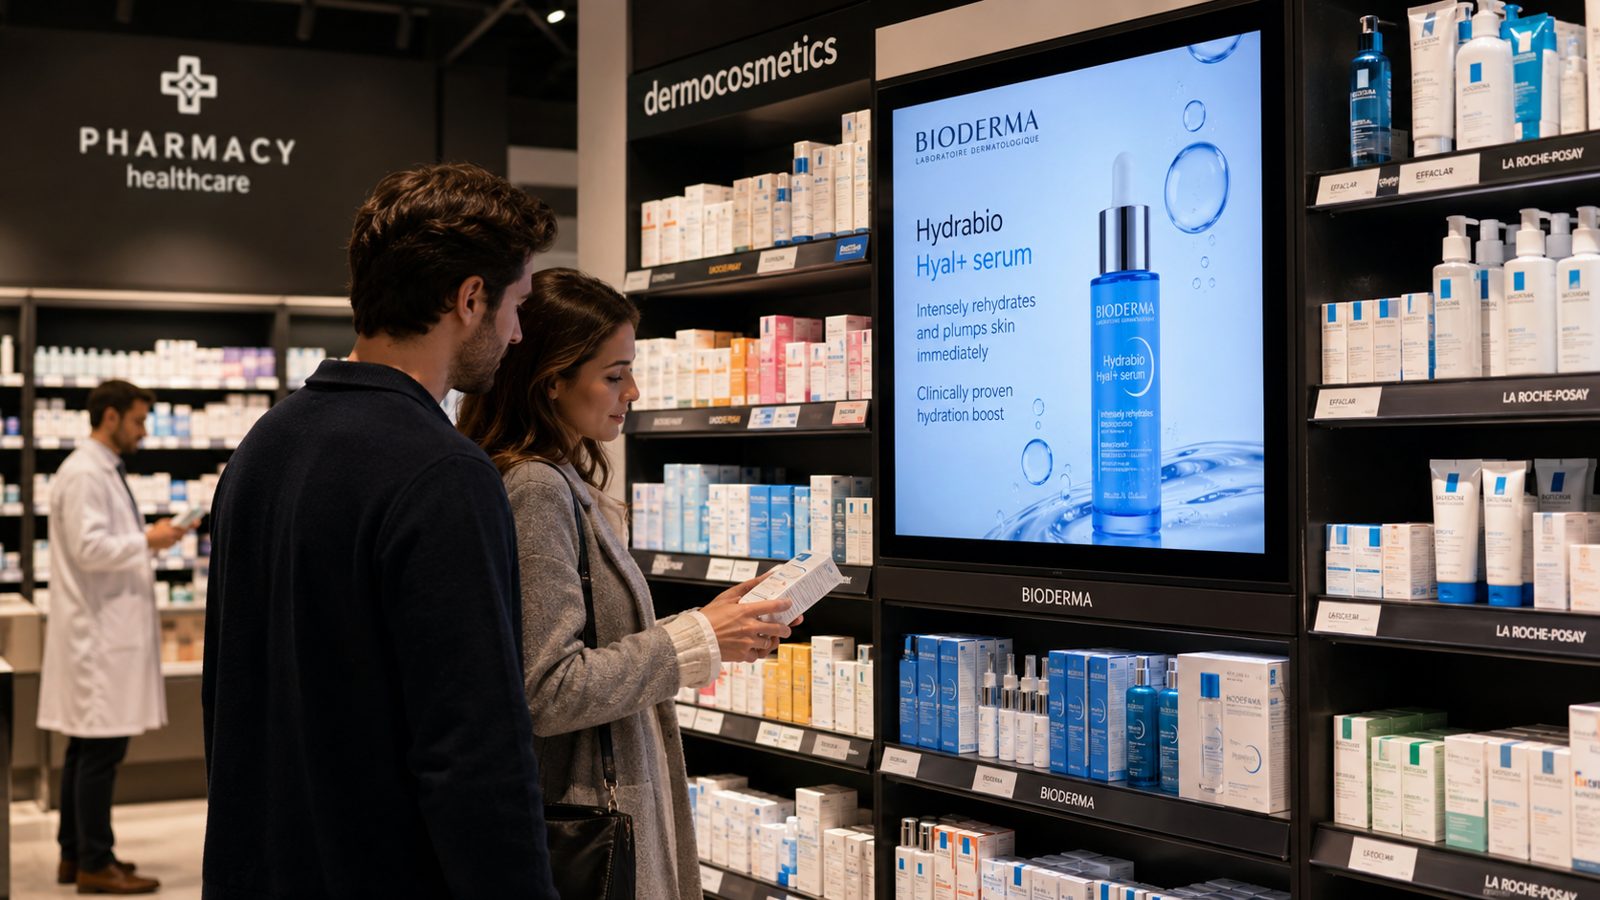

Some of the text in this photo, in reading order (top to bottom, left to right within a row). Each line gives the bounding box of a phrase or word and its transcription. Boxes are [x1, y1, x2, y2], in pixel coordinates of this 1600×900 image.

[644, 34, 838, 116] dermocosmetics
[915, 109, 1039, 152] BIODERMA
[79, 126, 296, 165] PHARMACY
[915, 134, 1039, 165] LABORATOIRE DERMATOLOGIQUE
[1502, 147, 1584, 170] LA ROCHE-POSAY
[126, 163, 250, 194] healthcare
[1414, 167, 1454, 180] EFFACLAR
[916, 208, 1003, 246] Hydrabio
[916, 247, 1032, 281] Hyal+ serum
[916, 294, 1036, 317] Intensely rehydrates
[1096, 302, 1155, 318] BIODERMA
[916, 318, 1015, 341] and plumps skin
[917, 343, 989, 362] immediately
[1103, 353, 1146, 370] Hydrabio
[1120, 370, 1146, 381] serum
[916, 384, 1013, 403] Clinically proven
[1503, 388, 1590, 403] LA ROCHE-POSAY
[917, 406, 1005, 426] hydration boost
[1022, 586, 1093, 608] BIODERMA
[1496, 625, 1587, 644] LA ROCHE-POSAY
[1040, 786, 1095, 810] BIODERMA
[1485, 874, 1499, 890] LA
[1501, 878, 1577, 900] ROCHE-POSAY
